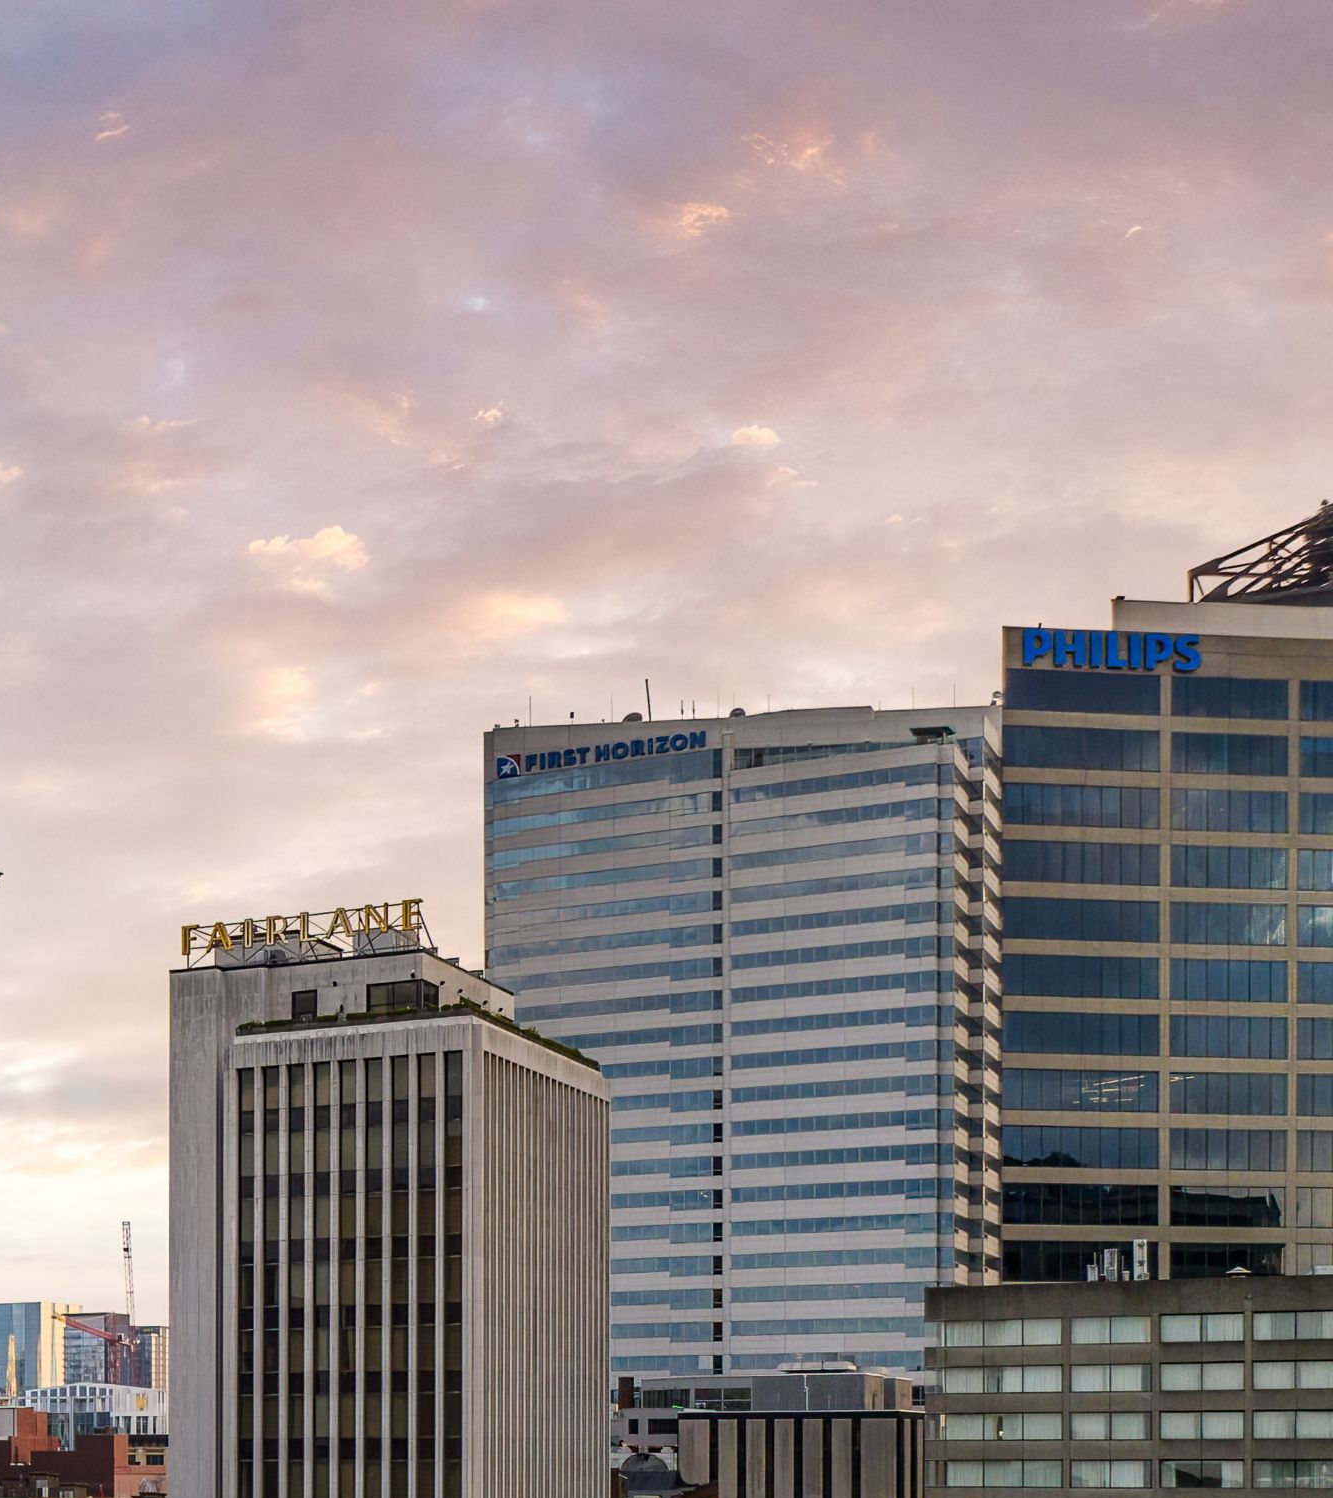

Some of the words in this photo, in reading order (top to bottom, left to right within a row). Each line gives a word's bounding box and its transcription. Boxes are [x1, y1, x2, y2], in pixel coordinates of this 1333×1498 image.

[1022, 627, 1202, 673] PHILIPS
[525, 747, 591, 772] FIRST
[595, 730, 706, 763] HORIZON
[181, 898, 424, 956] FAIRLANE
